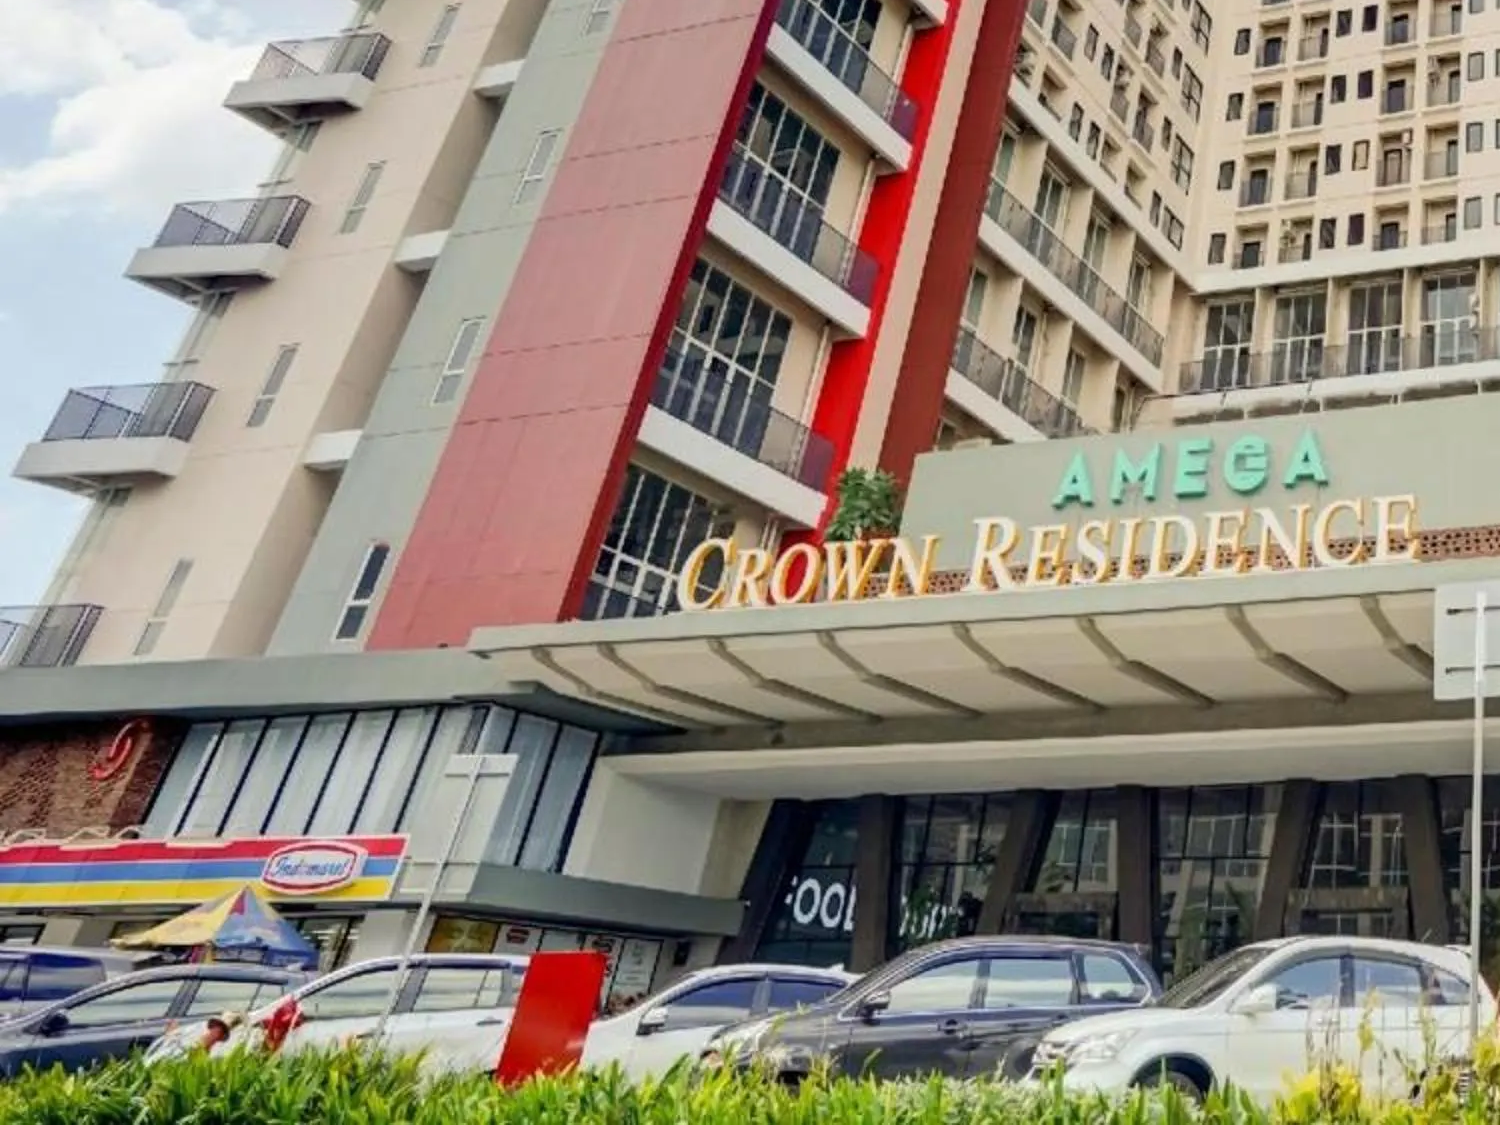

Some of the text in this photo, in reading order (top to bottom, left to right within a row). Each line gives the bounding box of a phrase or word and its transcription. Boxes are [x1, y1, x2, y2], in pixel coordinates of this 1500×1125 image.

[1051, 429, 1330, 509] AMEGA
[677, 493, 1421, 611] CROWN RESIDENCE
